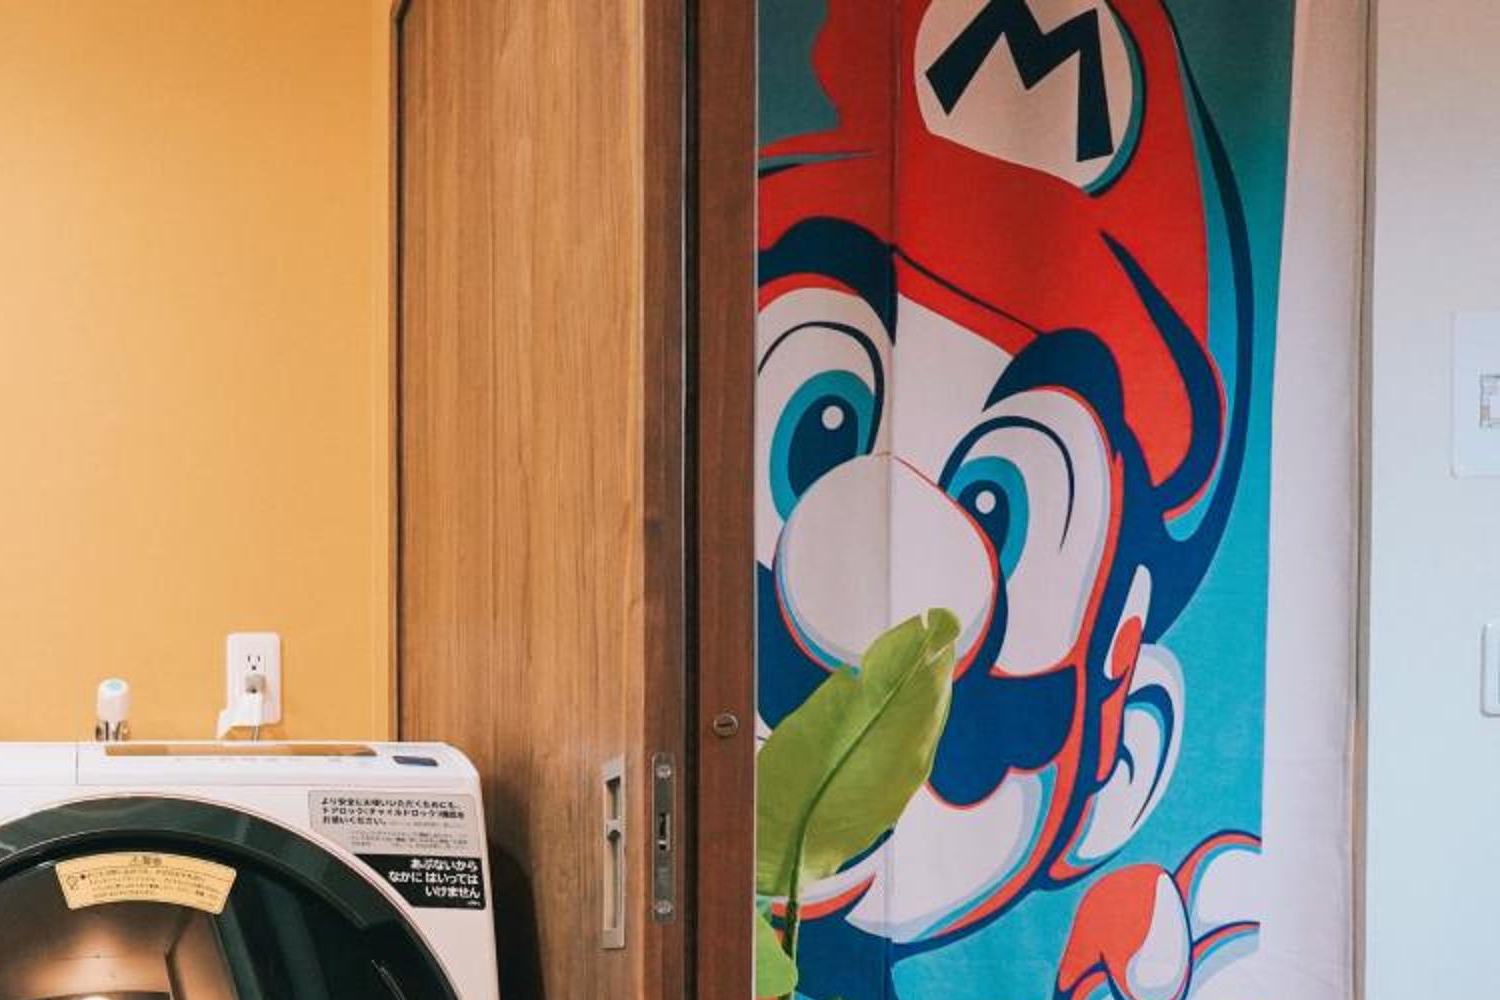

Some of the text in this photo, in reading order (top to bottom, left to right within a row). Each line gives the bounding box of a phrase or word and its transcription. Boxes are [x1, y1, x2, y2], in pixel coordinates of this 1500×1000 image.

[410, 858, 478, 871] あぶないから
[388, 870, 479, 885] なかに はいっては
[425, 885, 481, 898] いけません
